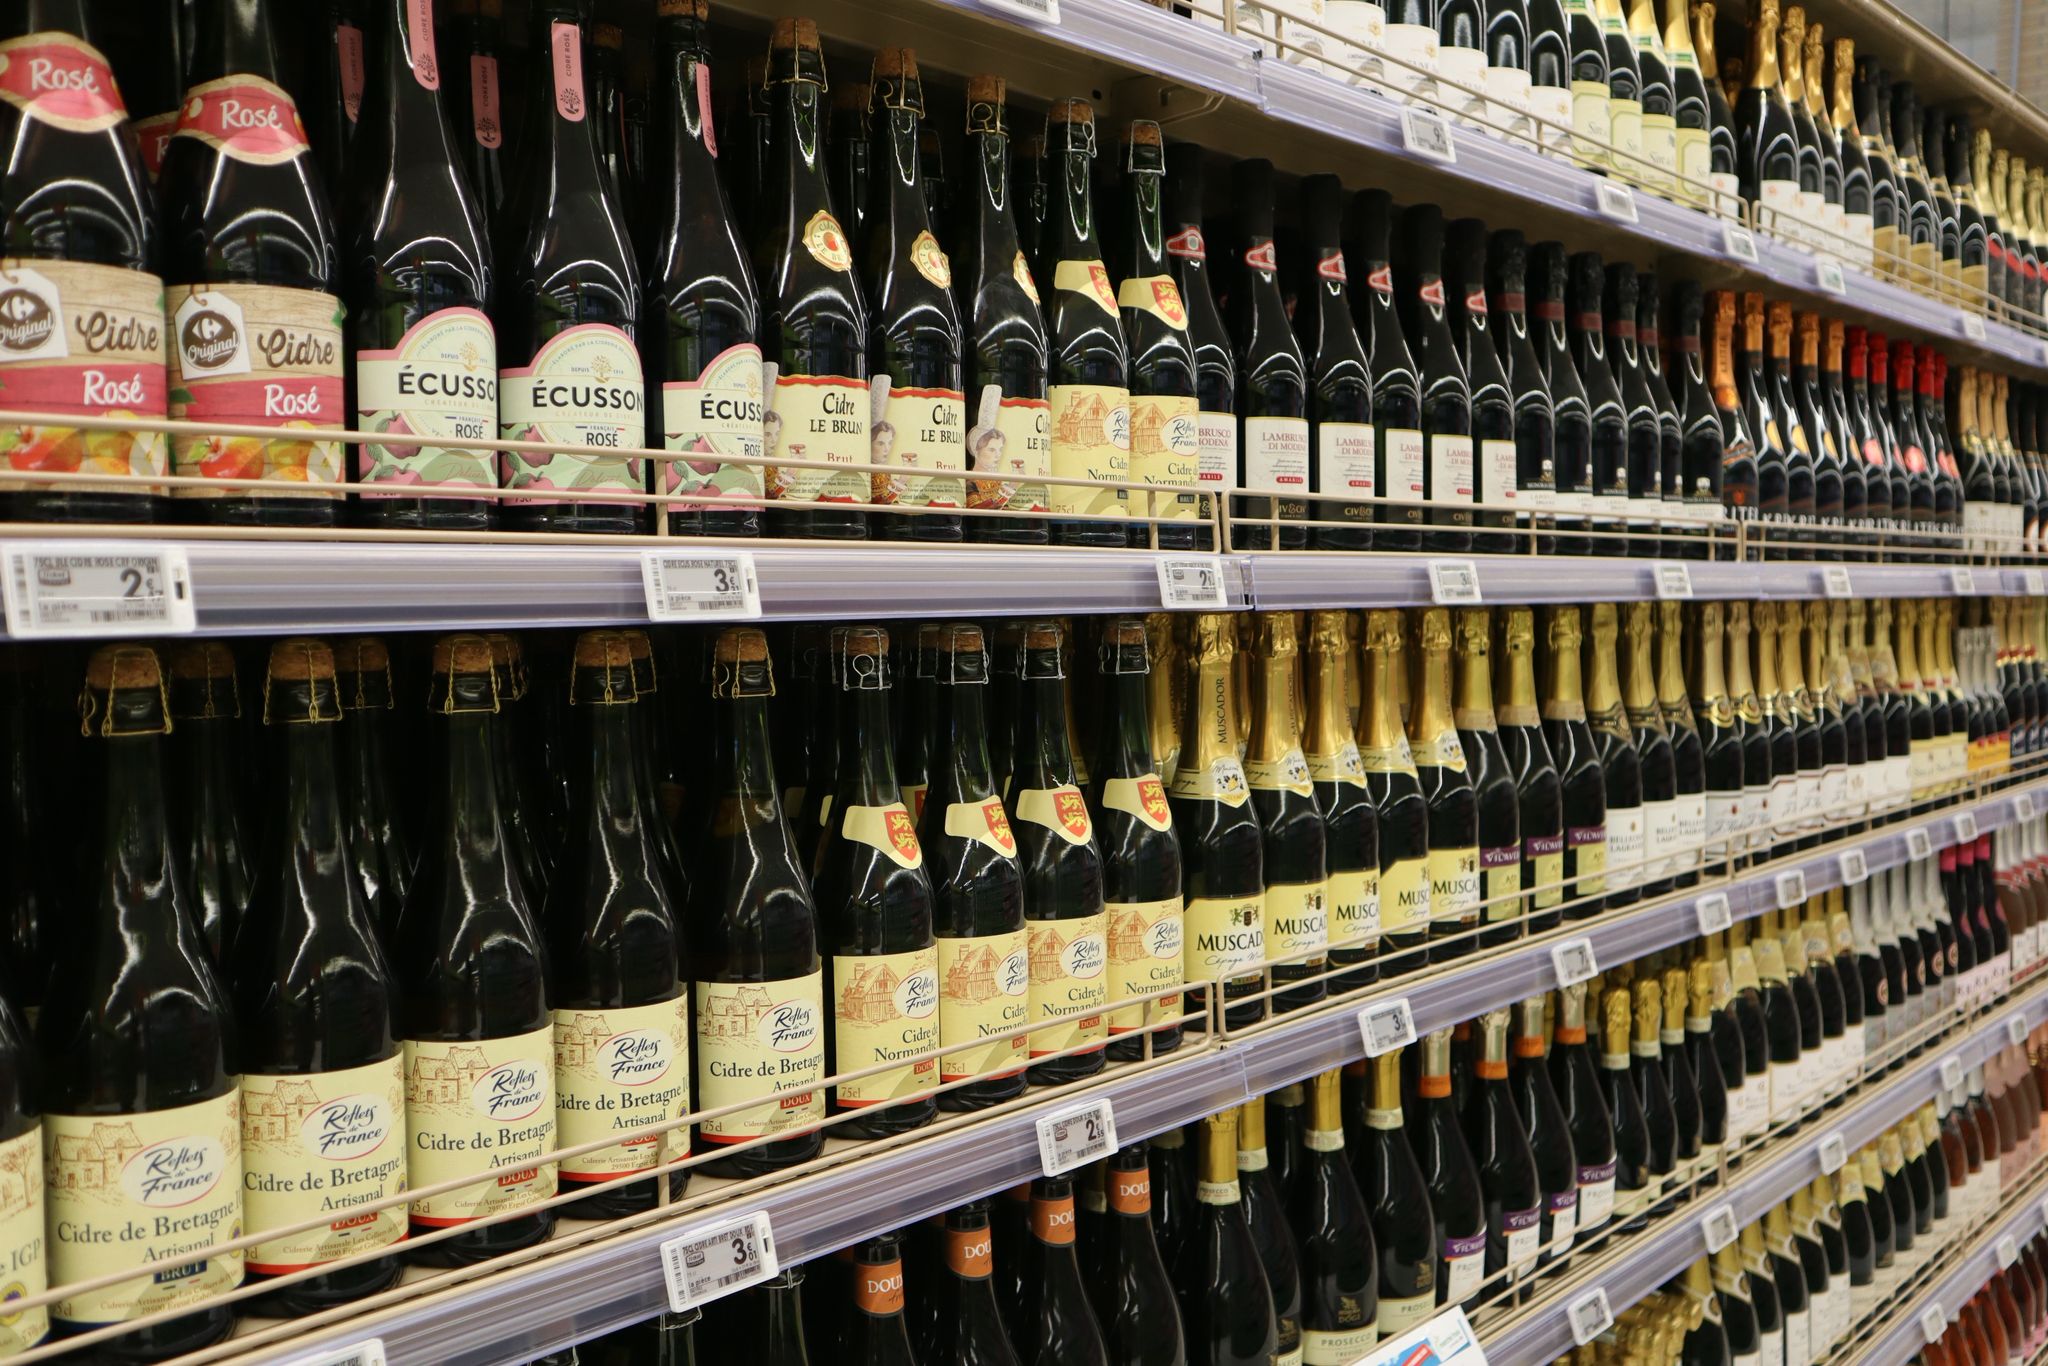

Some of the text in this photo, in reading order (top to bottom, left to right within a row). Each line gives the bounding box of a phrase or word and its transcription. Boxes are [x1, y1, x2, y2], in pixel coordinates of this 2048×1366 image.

[29, 57, 100, 94] Rosé
[219, 100, 283, 131] Rosé
[75, 311, 160, 353] Cidre
[187, 335, 240, 362] Original
[257, 329, 335, 369] Cidre
[82, 370, 146, 405] Rosé
[398, 364, 495, 401] ÉCUSSO
[264, 383, 321, 417] Rosé
[532, 379, 643, 412] ÉCUSSON
[822, 392, 855, 416] Cidre
[932, 404, 957, 426] Cidre
[455, 422, 485, 440] ROSÉ
[810, 419, 863, 434] LE BRUN
[921, 429, 935, 442] LE
[586, 430, 619, 448] ROSÉ
[1027, 437, 1038, 450] LE
[1199, 438, 1229, 447] ODENA
[120, 568, 142, 602] 2
[714, 568, 730, 595] 3
[1216, 676, 1228, 745] MUSCADOR
[1074, 940, 1101, 959] Reflets
[1071, 957, 1104, 975] France
[1150, 967, 1175, 981] Cidre
[908, 976, 936, 997] Reflets
[1068, 988, 1096, 1003] Cidre
[773, 1006, 812, 1027] Reflets
[905, 996, 938, 1016] France
[1080, 1017, 1100, 1029] DOUX
[1393, 1014, 1400, 1032] 3
[771, 1026, 815, 1047] France
[902, 1028, 930, 1045] Cidre
[611, 1037, 660, 1060] Reflets
[611, 1059, 665, 1080] France
[710, 1060, 753, 1077] Cidre
[757, 1060, 775, 1076] de
[915, 1060, 935, 1074] DOUX
[945, 1062, 965, 1074] 75cl
[491, 1069, 538, 1095] Reflets
[772, 1073, 817, 1094] Artisanal
[841, 1085, 862, 1099] 75cl
[488, 1090, 541, 1116] France
[556, 1086, 681, 1111] Cidre de Bretagne
[782, 1095, 811, 1109] DOUX
[321, 1104, 377, 1130] Reflets
[612, 1109, 667, 1130] Artisanal
[318, 1126, 382, 1154] France
[417, 1131, 465, 1151] Cidre
[471, 1131, 492, 1149] de
[1086, 1119, 1097, 1141] 2
[144, 1146, 209, 1175] Reflets
[489, 1144, 543, 1169] Artisanal
[244, 1153, 400, 1192] Cidre de Bretagne
[500, 1167, 537, 1184] DOUX
[140, 1170, 213, 1202] France
[320, 1184, 383, 1212] Artisanal
[57, 1200, 234, 1244] Cidre de Bretagne
[11, 1236, 42, 1272] IGP
[142, 1232, 216, 1263] Artisanal
[732, 1238, 747, 1265] 3
[160, 1261, 204, 1282] BRUT
[1321, 1332, 1373, 1348] PROSECCO
